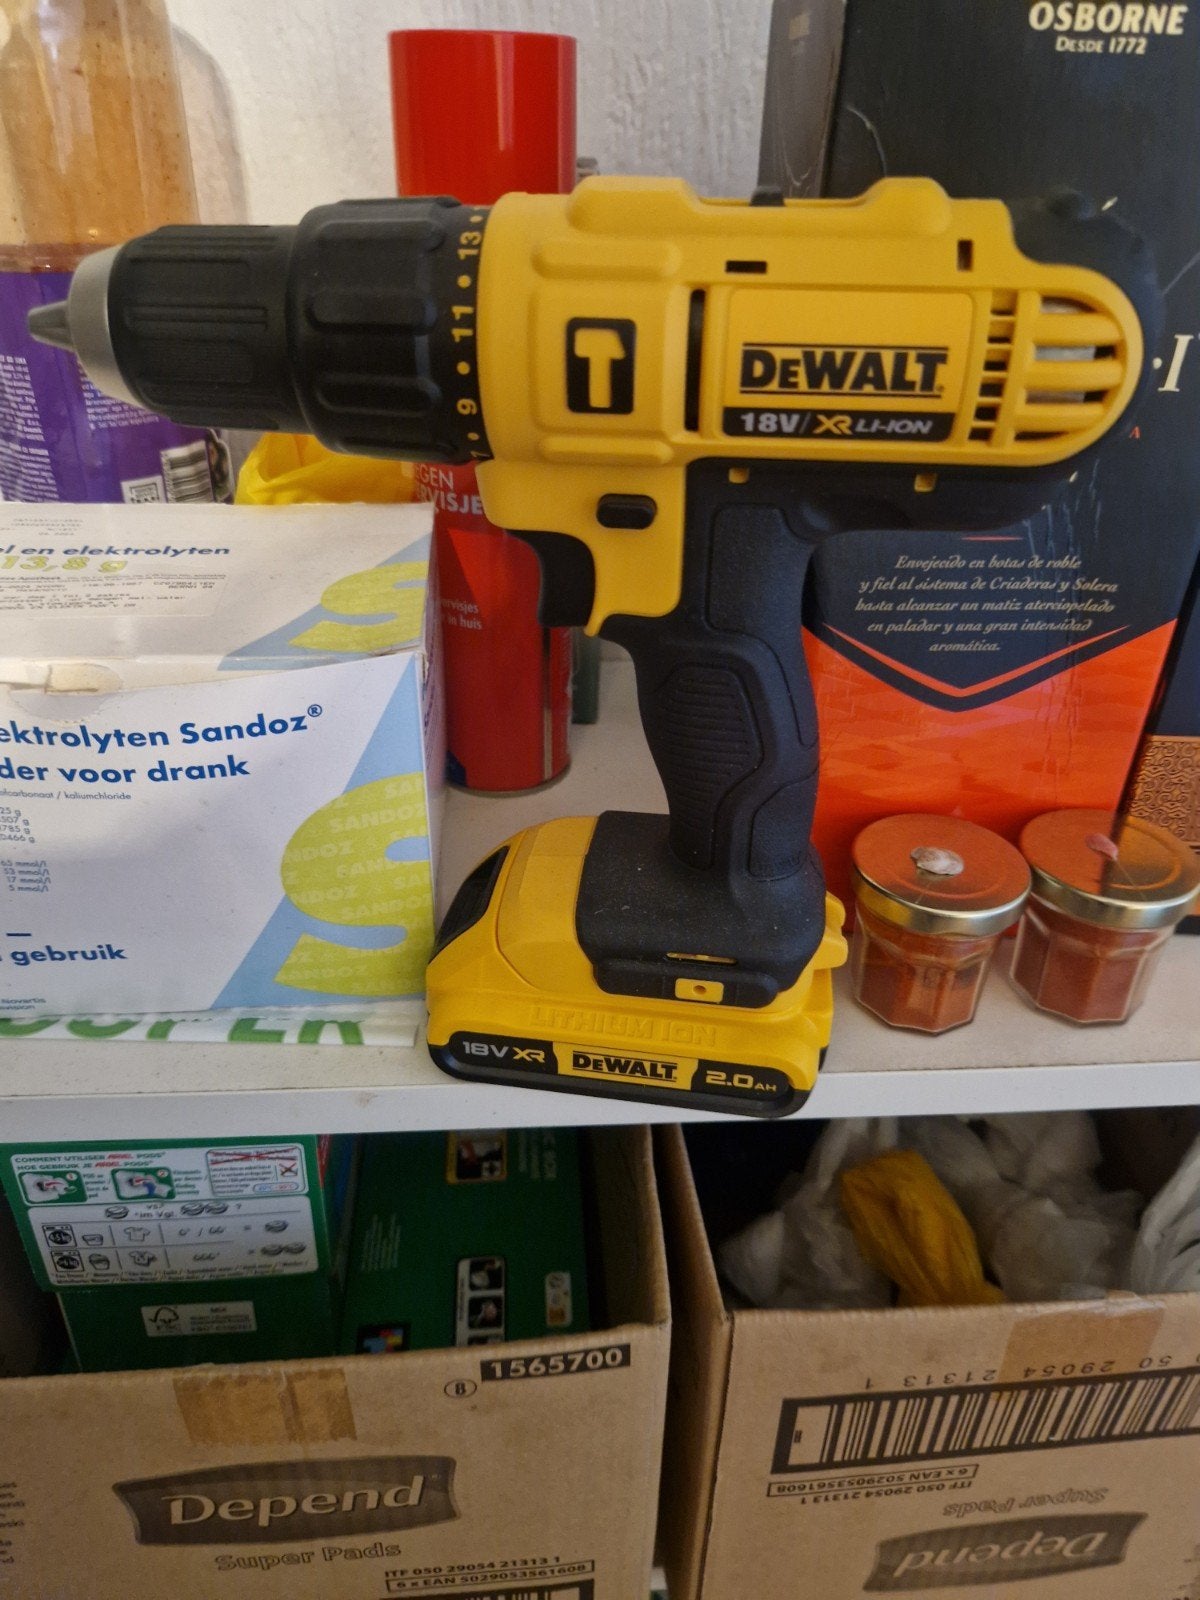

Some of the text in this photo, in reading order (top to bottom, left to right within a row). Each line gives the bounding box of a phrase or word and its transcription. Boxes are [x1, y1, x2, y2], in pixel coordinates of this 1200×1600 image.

[1029, 2, 1188, 35] OSBORNE
[1109, 37, 1147, 55] 1772
[459, 231, 482, 260] 13
[452, 306, 474, 343] 11
[855, 418, 932, 434] LI-ION
[21, 547, 54, 556] en
[63, 545, 231, 558] elektrolyten
[1, 556, 90, 572] 13,8
[895, 555, 1082, 571] Envejecido en botas de roble
[859, 577, 1119, 593] y fiel al sistema de Criaderas y Solera
[897, 599, 957, 612] alcanzar
[961, 602, 978, 611] un
[982, 599, 1021, 611] matiz
[1024, 599, 1115, 614] aterciopelado
[868, 619, 1092, 635] en paladar y una gran intensidad
[929, 640, 1000, 652] aromática.
[57, 766, 136, 784] voor
[147, 755, 250, 783] drank
[64, 791, 132, 801] kaliumchloride
[11, 944, 128, 966] gebruik
[531, 1006, 717, 1046] LITHIUM ION
[463, 1041, 546, 1064] 18V XR
[490, 1347, 624, 1379] 1565700
[1023, 1360, 1115, 1378] 29054
[903, 1369, 998, 1387] 21313
[910, 1469, 945, 1481] EAN
[161, 1475, 424, 1527] Depend
[214, 1542, 401, 1571] Super Pads
[893, 1531, 1108, 1578] Depend
[385, 1569, 411, 1578] ITF
[422, 1577, 456, 1587] EAN
